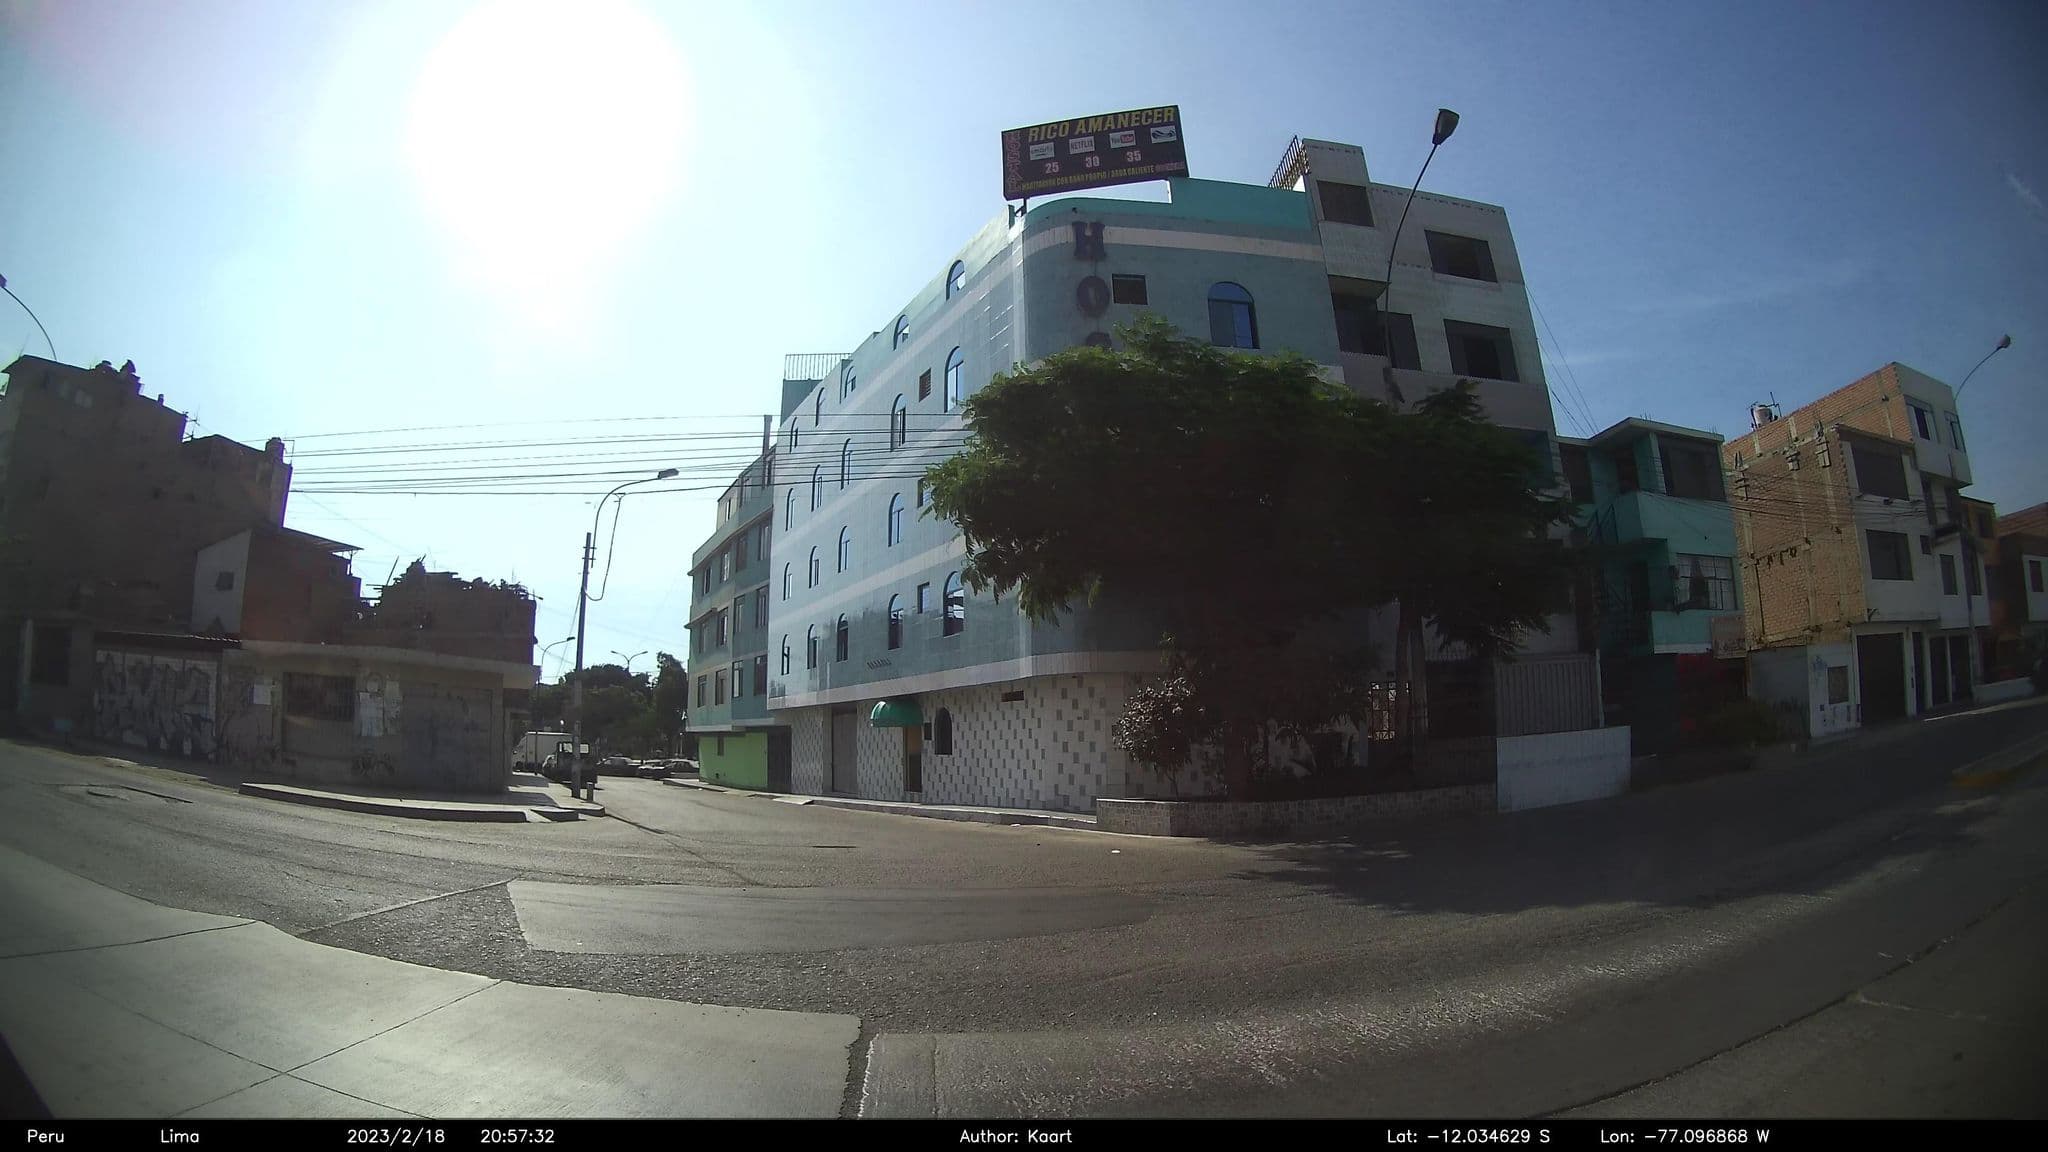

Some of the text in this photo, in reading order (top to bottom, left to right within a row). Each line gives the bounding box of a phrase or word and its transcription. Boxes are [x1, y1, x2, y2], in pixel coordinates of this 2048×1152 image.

[1028, 107, 1176, 143] RICO AMANECER
[1126, 150, 1142, 162] 35
[1045, 162, 1060, 174] 25
